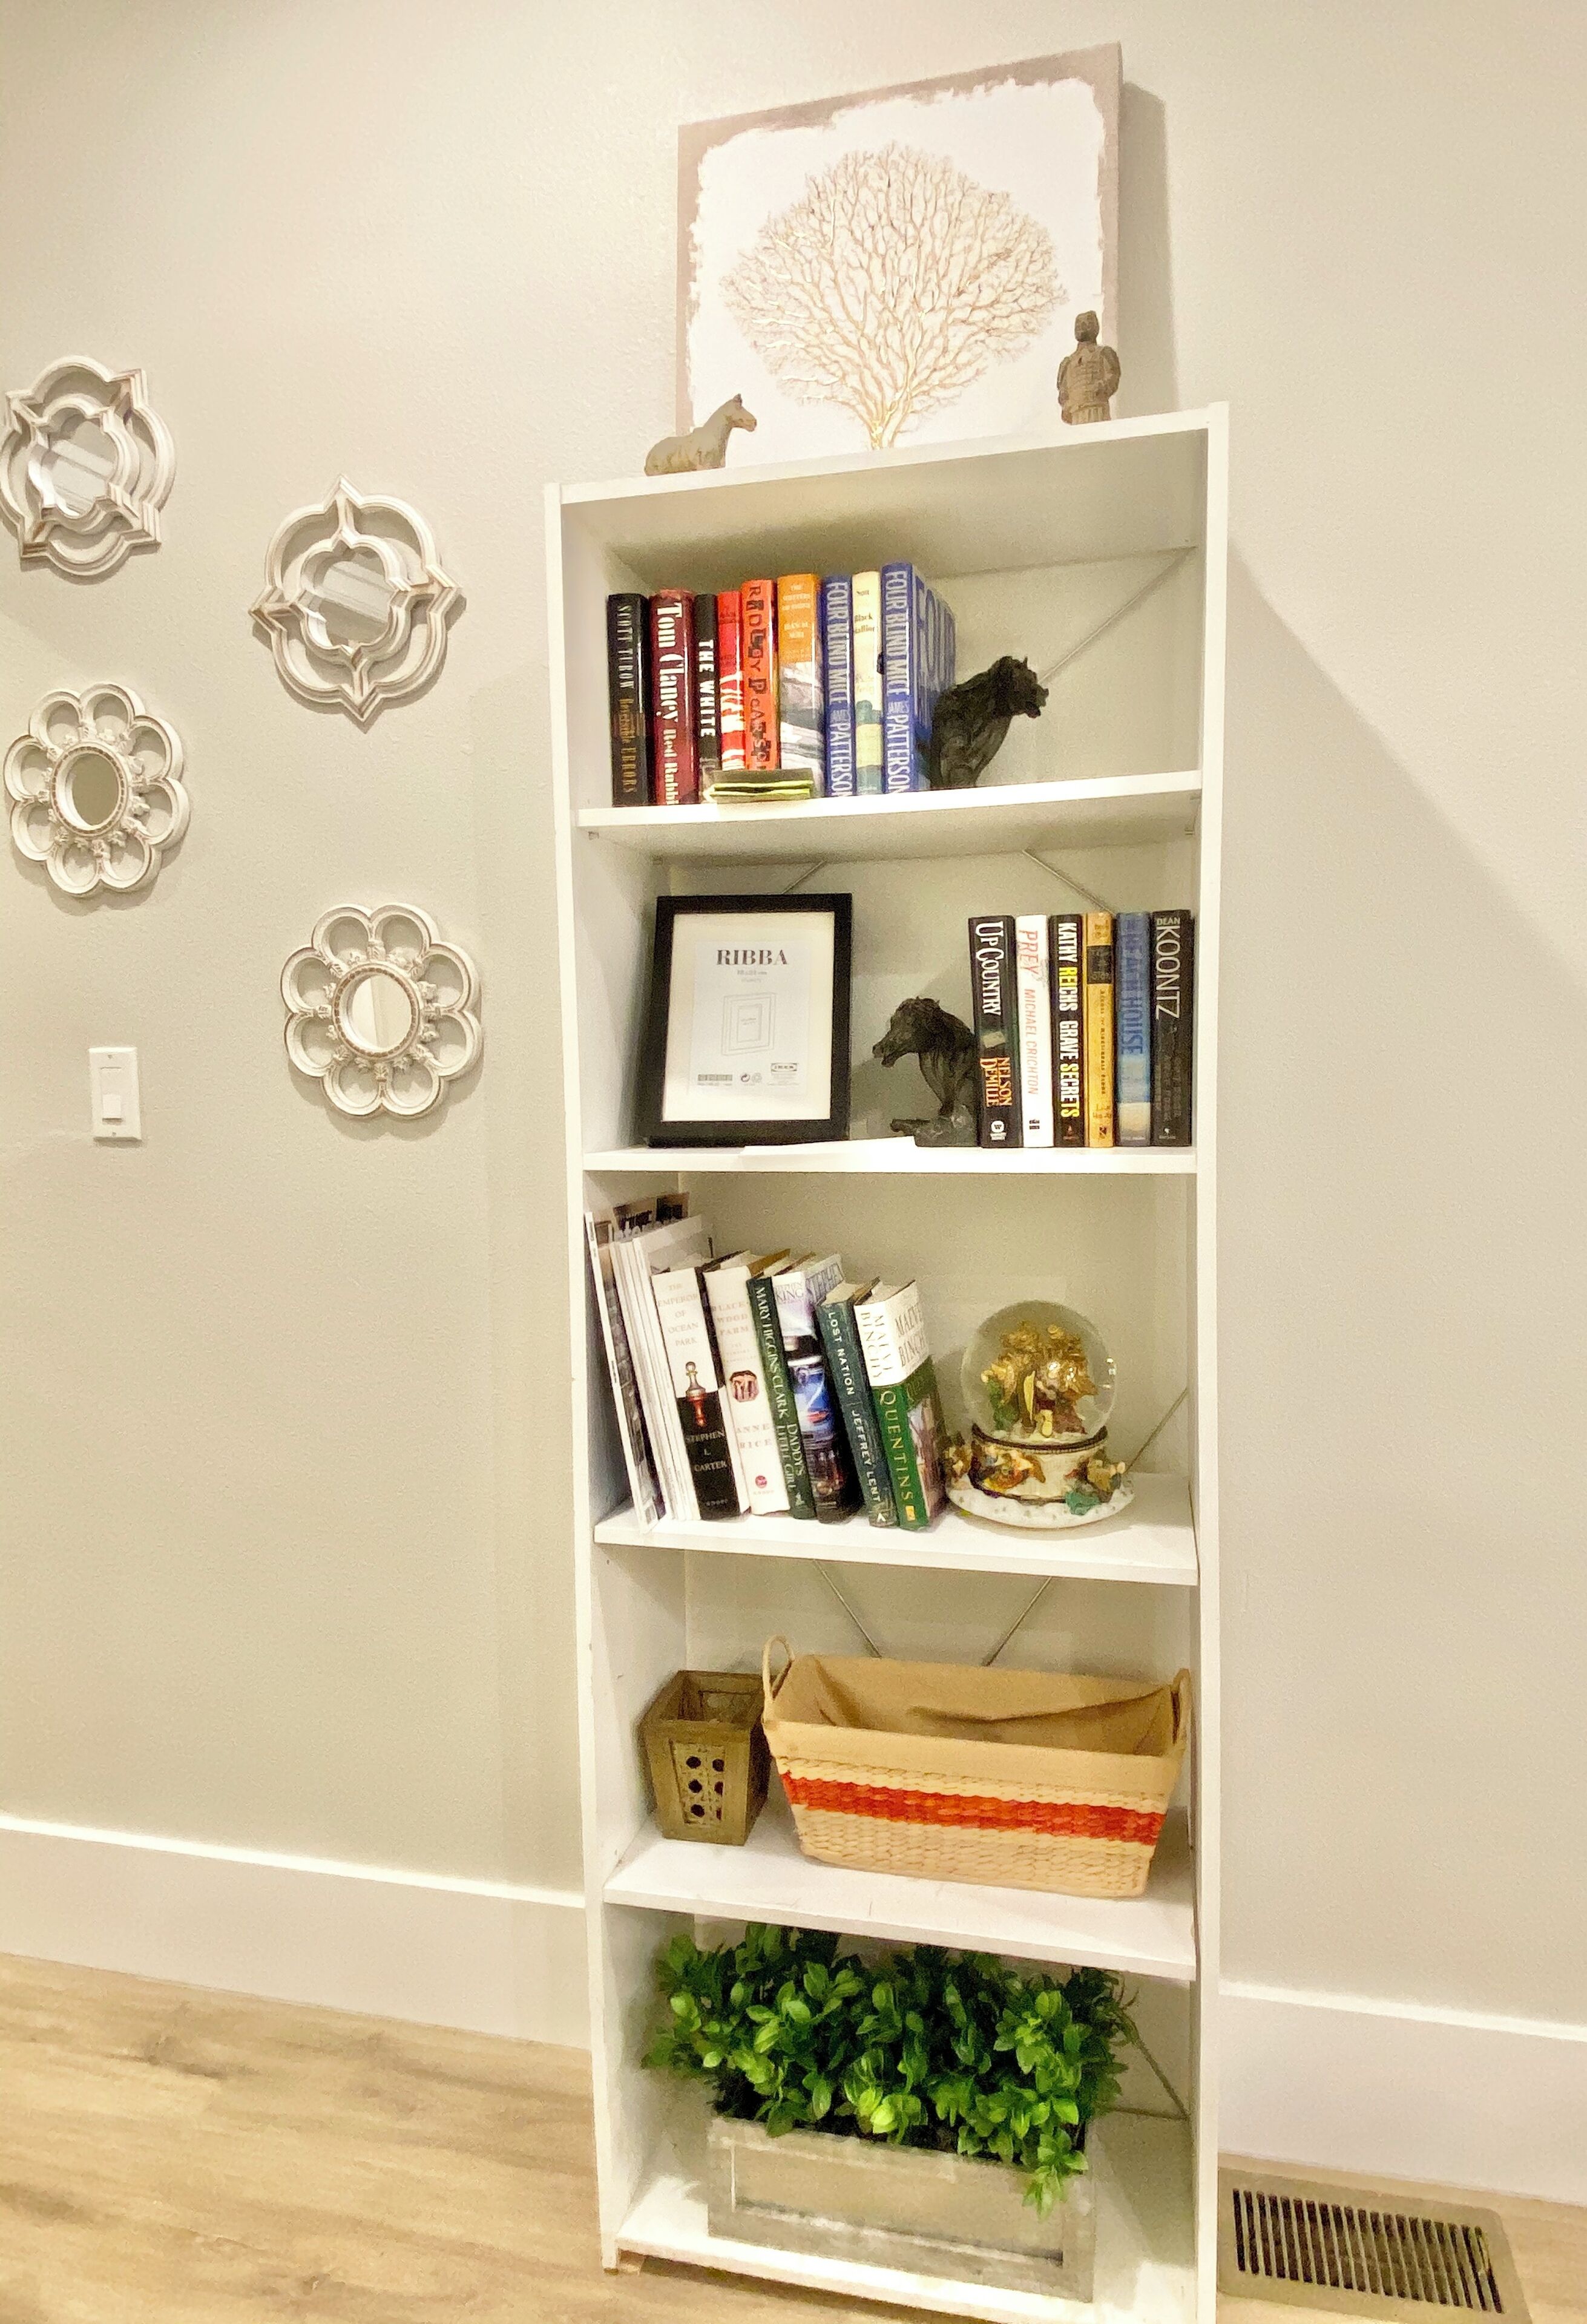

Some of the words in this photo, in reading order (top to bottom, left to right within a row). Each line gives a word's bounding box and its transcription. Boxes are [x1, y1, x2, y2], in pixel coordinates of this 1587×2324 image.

[827, 582, 848, 620] FOUR
[886, 570, 908, 611] FOUR
[617, 605, 634, 642] SCOTT
[657, 602, 683, 648] Tom
[827, 623, 848, 666] BLIND
[886, 614, 907, 657] BLIND
[618, 648, 635, 689] TUROW
[699, 639, 714, 673] THE
[656, 653, 685, 723] Clancy
[829, 668, 849, 706] MICE
[886, 659, 908, 697] MICE
[700, 680, 717, 737] WHITE
[663, 728, 677, 758] Red
[665, 763, 679, 805] Rabbi
[975, 921, 1004, 945] UP
[1156, 916, 1181, 926] DEAN
[716, 949, 789, 966] RIBBA
[1019, 930, 1039, 976] PREY
[1058, 923, 1078, 962] KATHY
[976, 948, 1005, 1016] COUNTRY
[1059, 967, 1078, 1011] REICHS
[1155, 925, 1181, 1020] KOONTZ
[1024, 989, 1036, 1039] MICHAEL
[1059, 1020, 1079, 1060] GRAVE
[997, 1057, 1012, 1106] NELSON
[1025, 1040, 1039, 1095] CRICHTON
[1060, 1063, 1080, 1118] SECRETS
[756, 1287, 771, 1319] MARY
[775, 1287, 804, 1302] KING
[668, 1322, 698, 1334] OCEAN
[763, 1324, 781, 1374] HIGGINS
[827, 1311, 843, 1343] LOST
[836, 1348, 855, 1396] NATION
[772, 1375, 790, 1419] CLARK
[694, 1460, 727, 1472] CARTER
[852, 1410, 873, 1466] JEFFREY
[866, 1471, 881, 1503] LENT
[880, 1390, 915, 1500] QUENTINS
